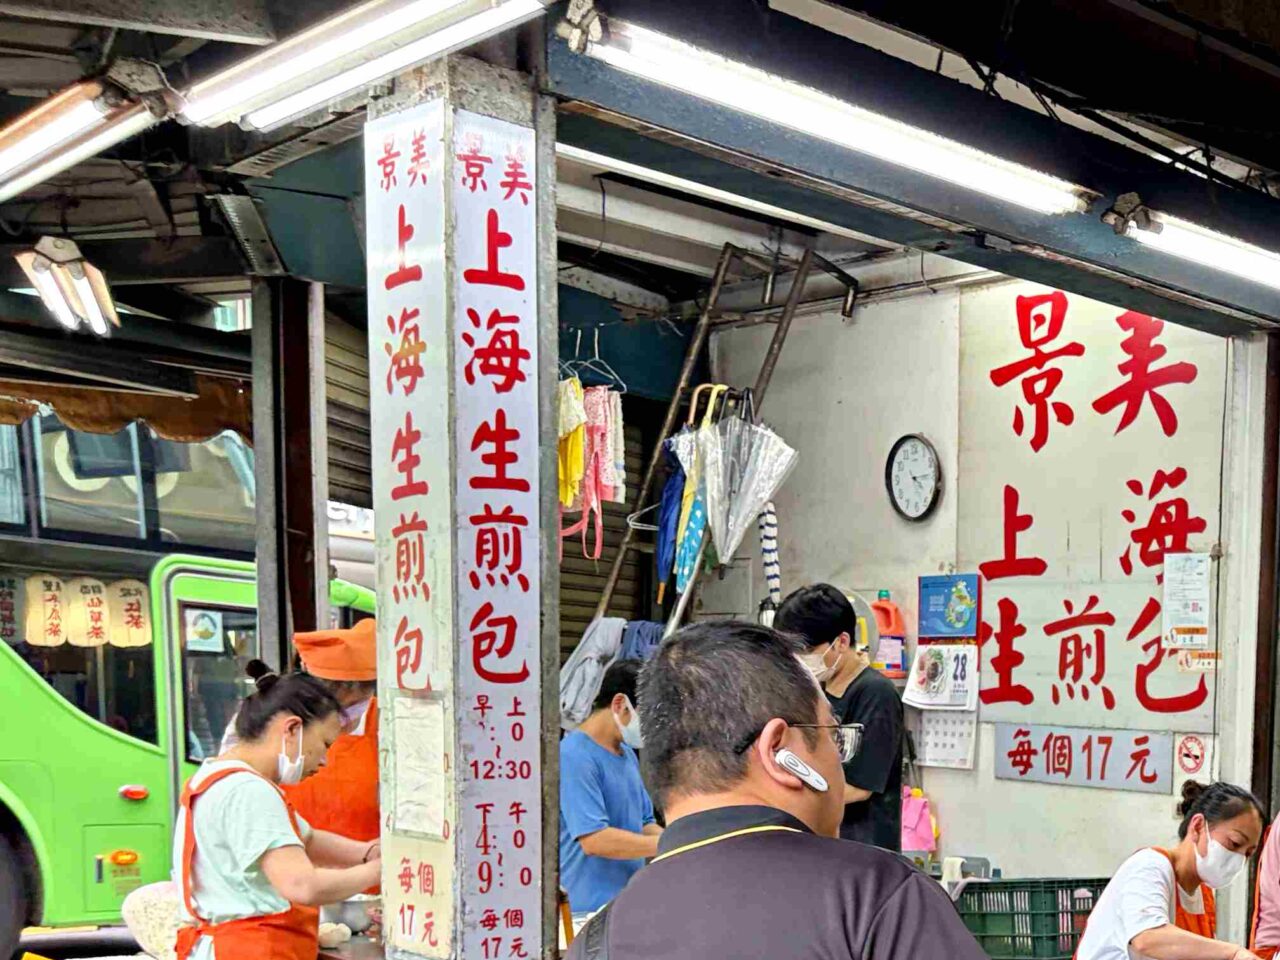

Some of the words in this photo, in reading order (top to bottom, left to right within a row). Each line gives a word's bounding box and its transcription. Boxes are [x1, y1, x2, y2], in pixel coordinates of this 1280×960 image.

[377, 128, 430, 190] 景美
[457, 131, 533, 206] 景美
[990, 291, 1198, 453] 景美
[384, 203, 432, 692] 上海生煎包
[461, 208, 531, 684] 上海生煎包
[979, 467, 1207, 585] 上海
[953, 653, 967, 681] 28
[469, 760, 532, 780] 12:30
[398, 858, 435, 897] 每個
[480, 908, 524, 931] 每個
